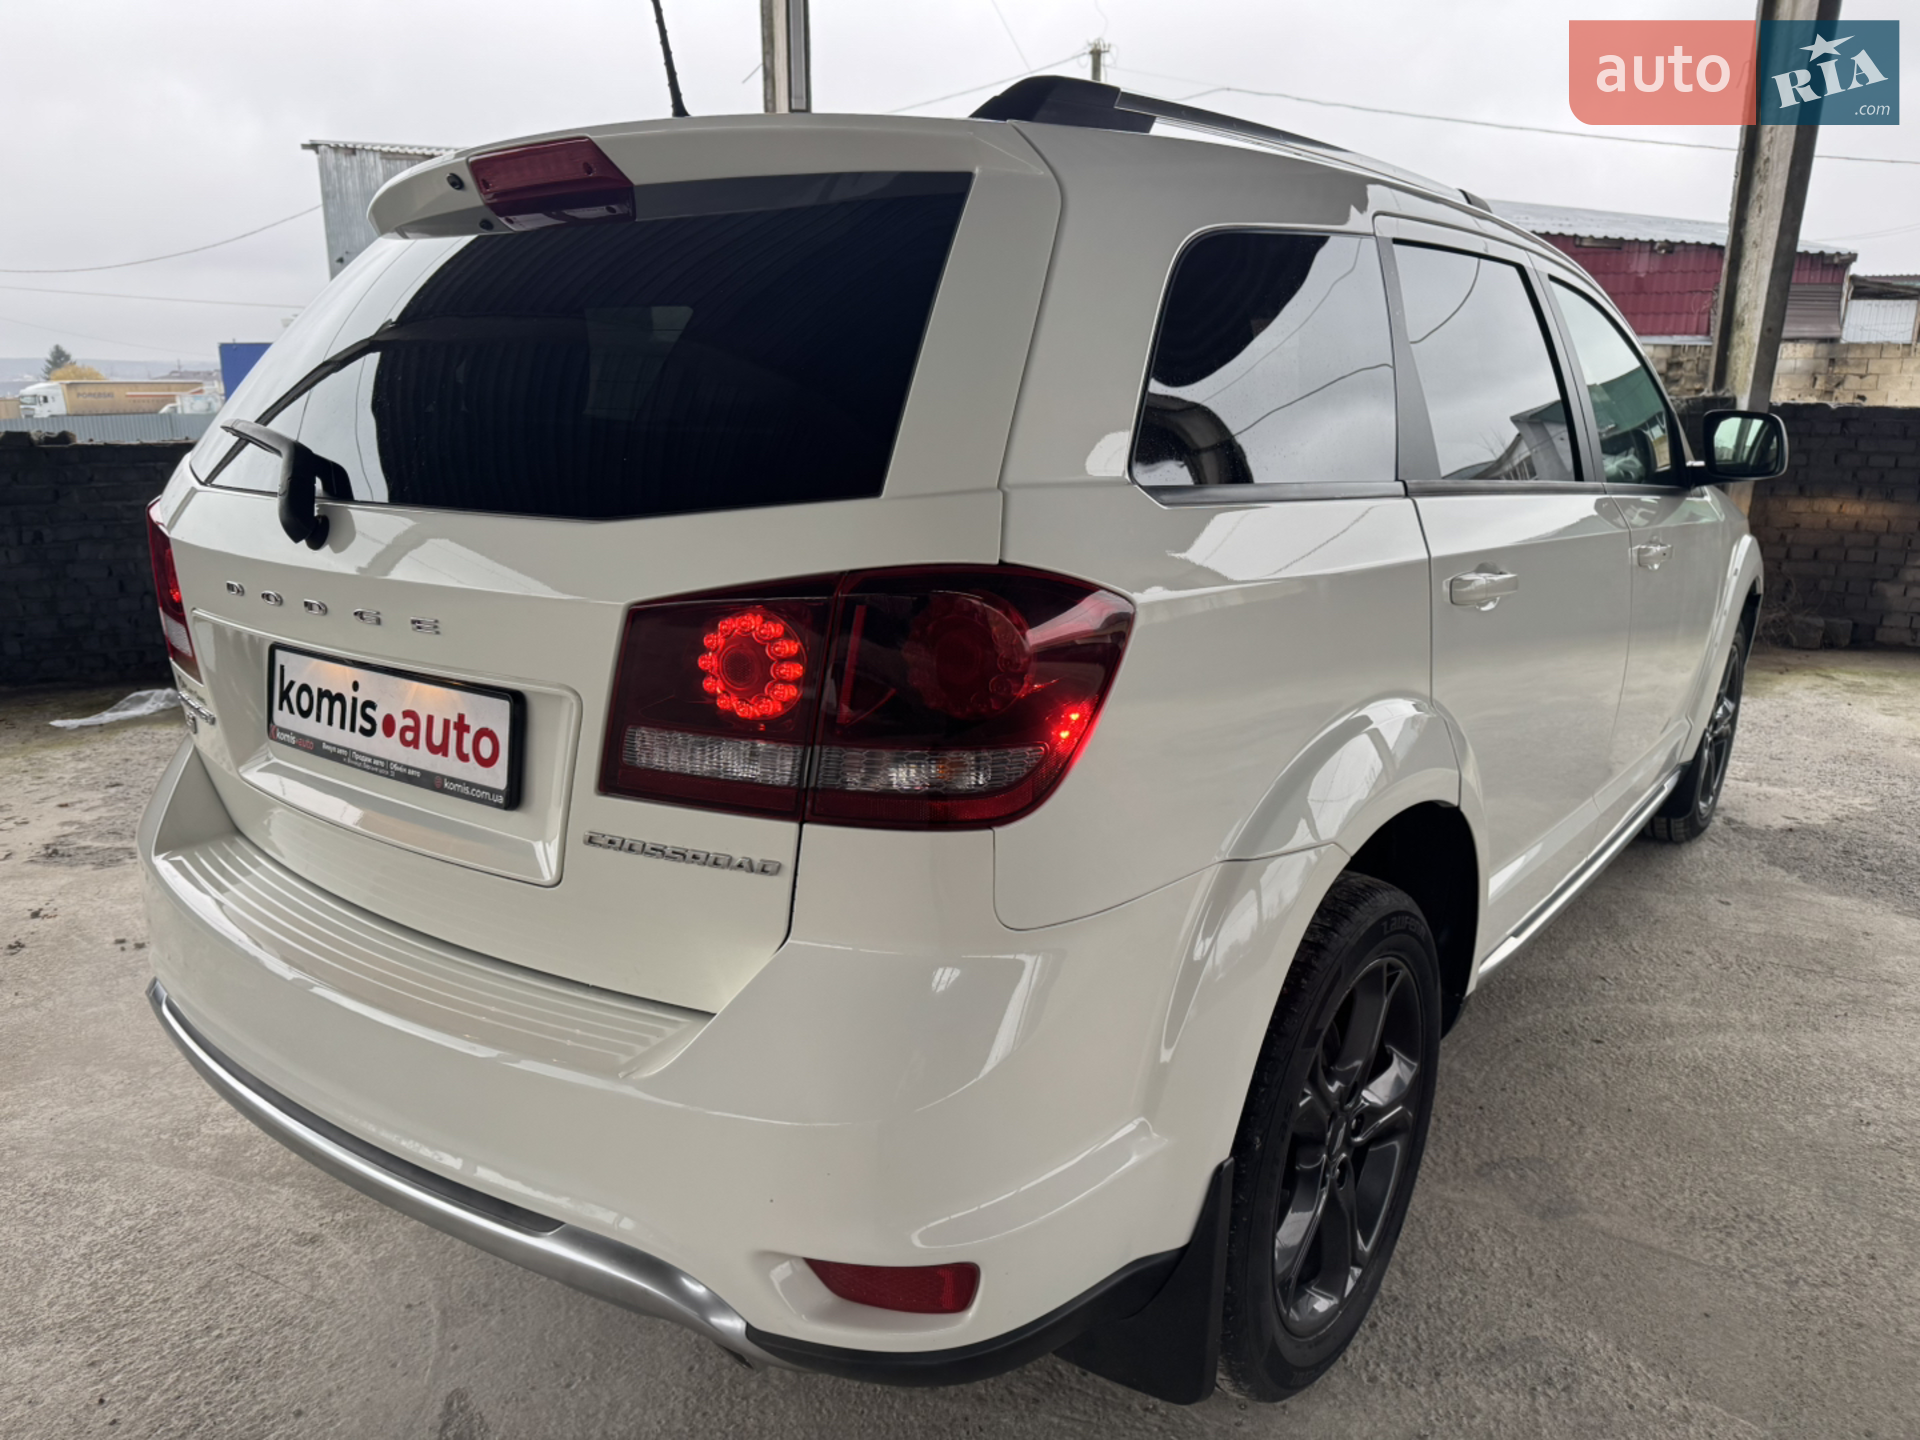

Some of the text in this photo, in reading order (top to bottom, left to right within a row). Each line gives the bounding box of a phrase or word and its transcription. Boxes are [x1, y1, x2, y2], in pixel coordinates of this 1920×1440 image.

[226, 581, 441, 635] DODGE
[443, 777, 504, 804] komis.com.ua
[583, 830, 782, 877] CROSSROAD
